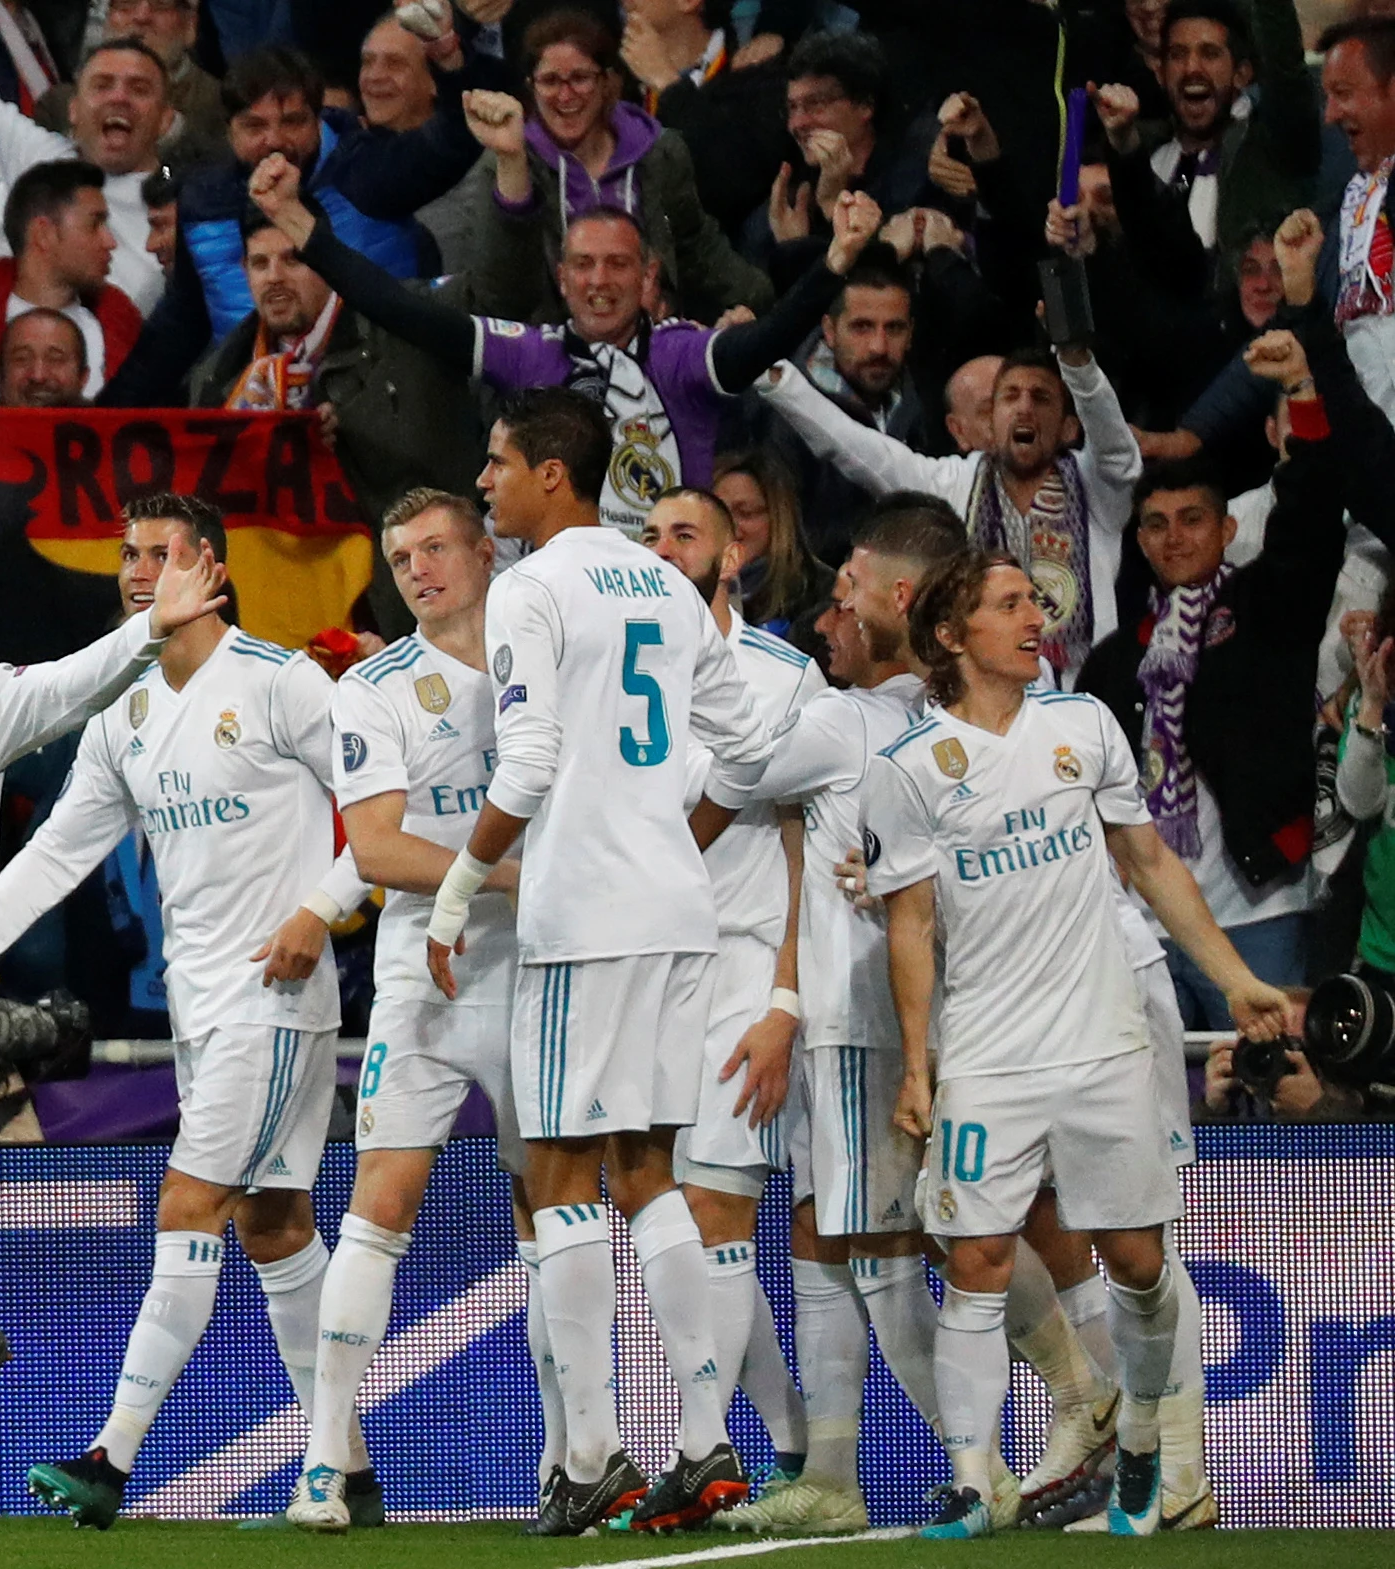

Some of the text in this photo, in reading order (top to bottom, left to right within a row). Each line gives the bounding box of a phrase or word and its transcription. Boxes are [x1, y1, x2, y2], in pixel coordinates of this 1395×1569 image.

[584, 566, 672, 598] VARANE
[620, 618, 673, 767] 5
[158, 770, 191, 795] Fly
[138, 794, 250, 835] Emirates
[1003, 807, 1046, 835] Fly
[955, 821, 1093, 881] Emirates
[361, 1042, 387, 1098] 8
[941, 1119, 987, 1182] 10
[321, 1330, 371, 1346] RMCF
[123, 1373, 161, 1388] MCF
